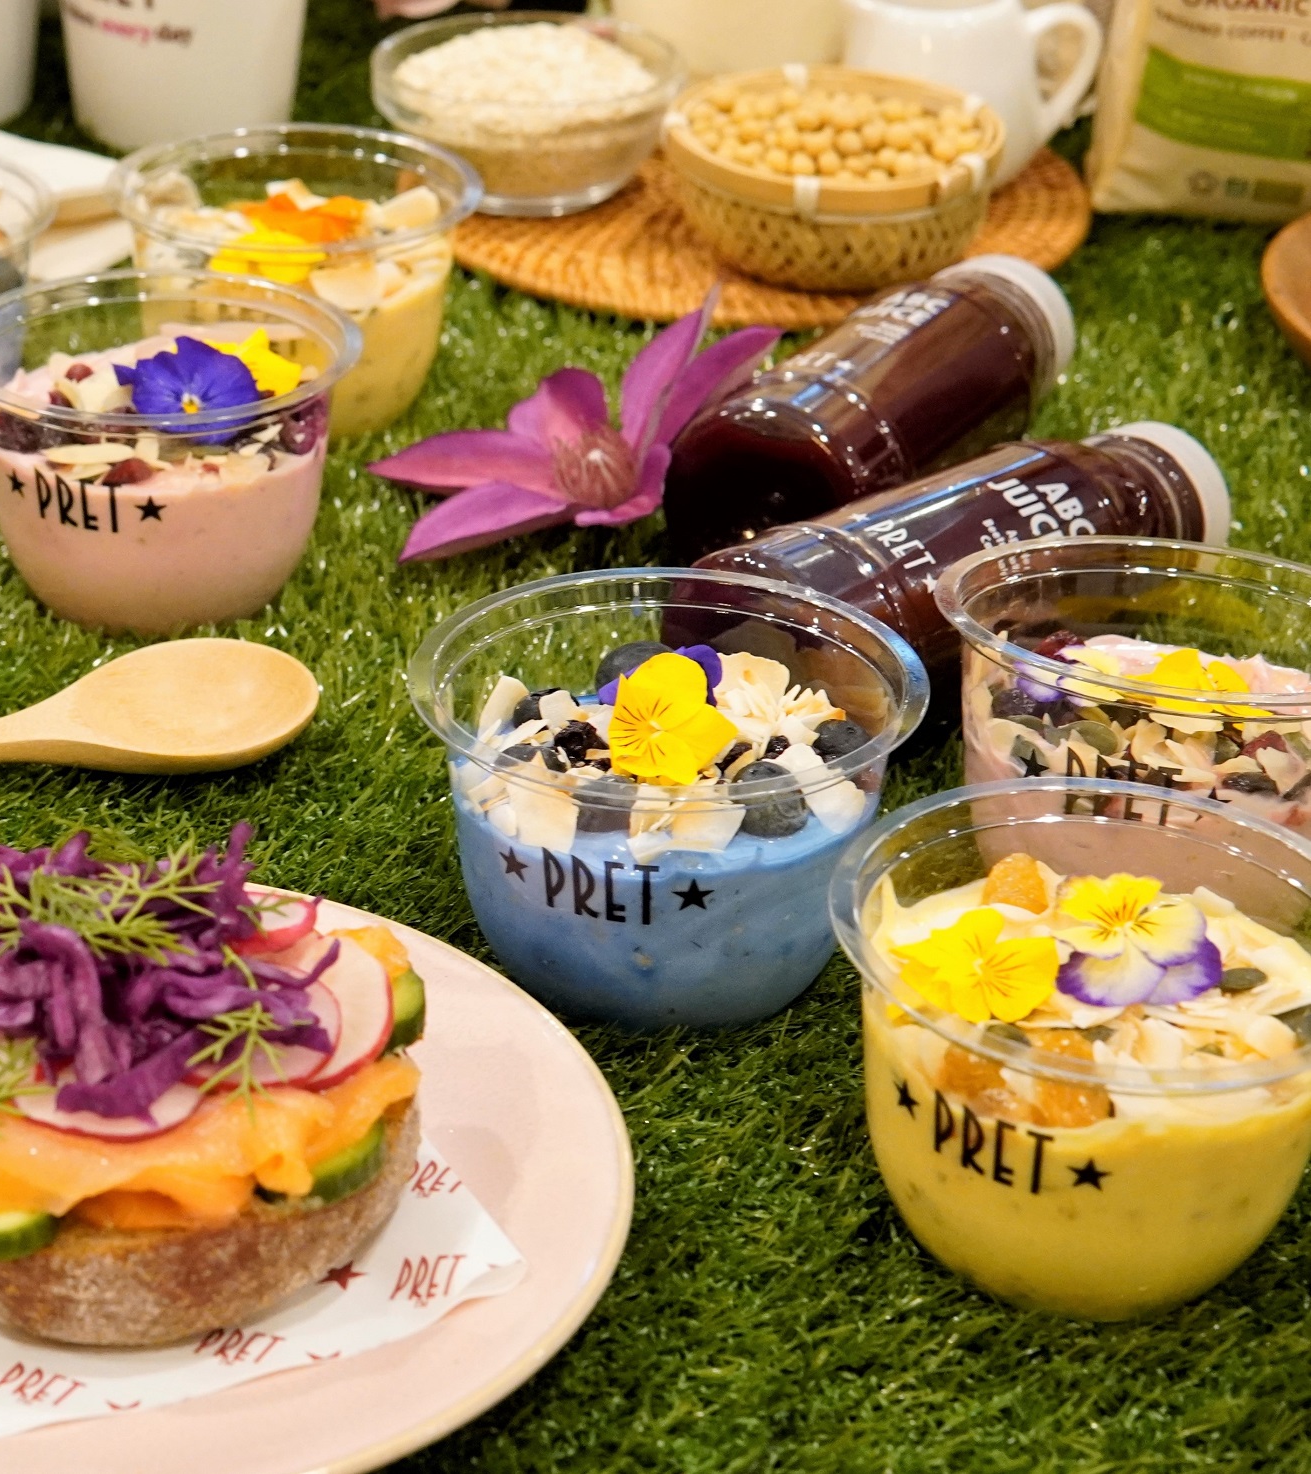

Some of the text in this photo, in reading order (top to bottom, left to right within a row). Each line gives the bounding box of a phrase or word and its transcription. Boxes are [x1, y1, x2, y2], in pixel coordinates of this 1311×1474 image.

[34, 468, 126, 534] PRET
[1035, 481, 1097, 537] ABC
[863, 518, 937, 571] PRET
[1064, 746, 1184, 827] PRET
[540, 846, 662, 926] PRET
[933, 1089, 1055, 1196] PRET
[389, 1254, 467, 1302] PRET
[194, 1327, 287, 1366] PRET
